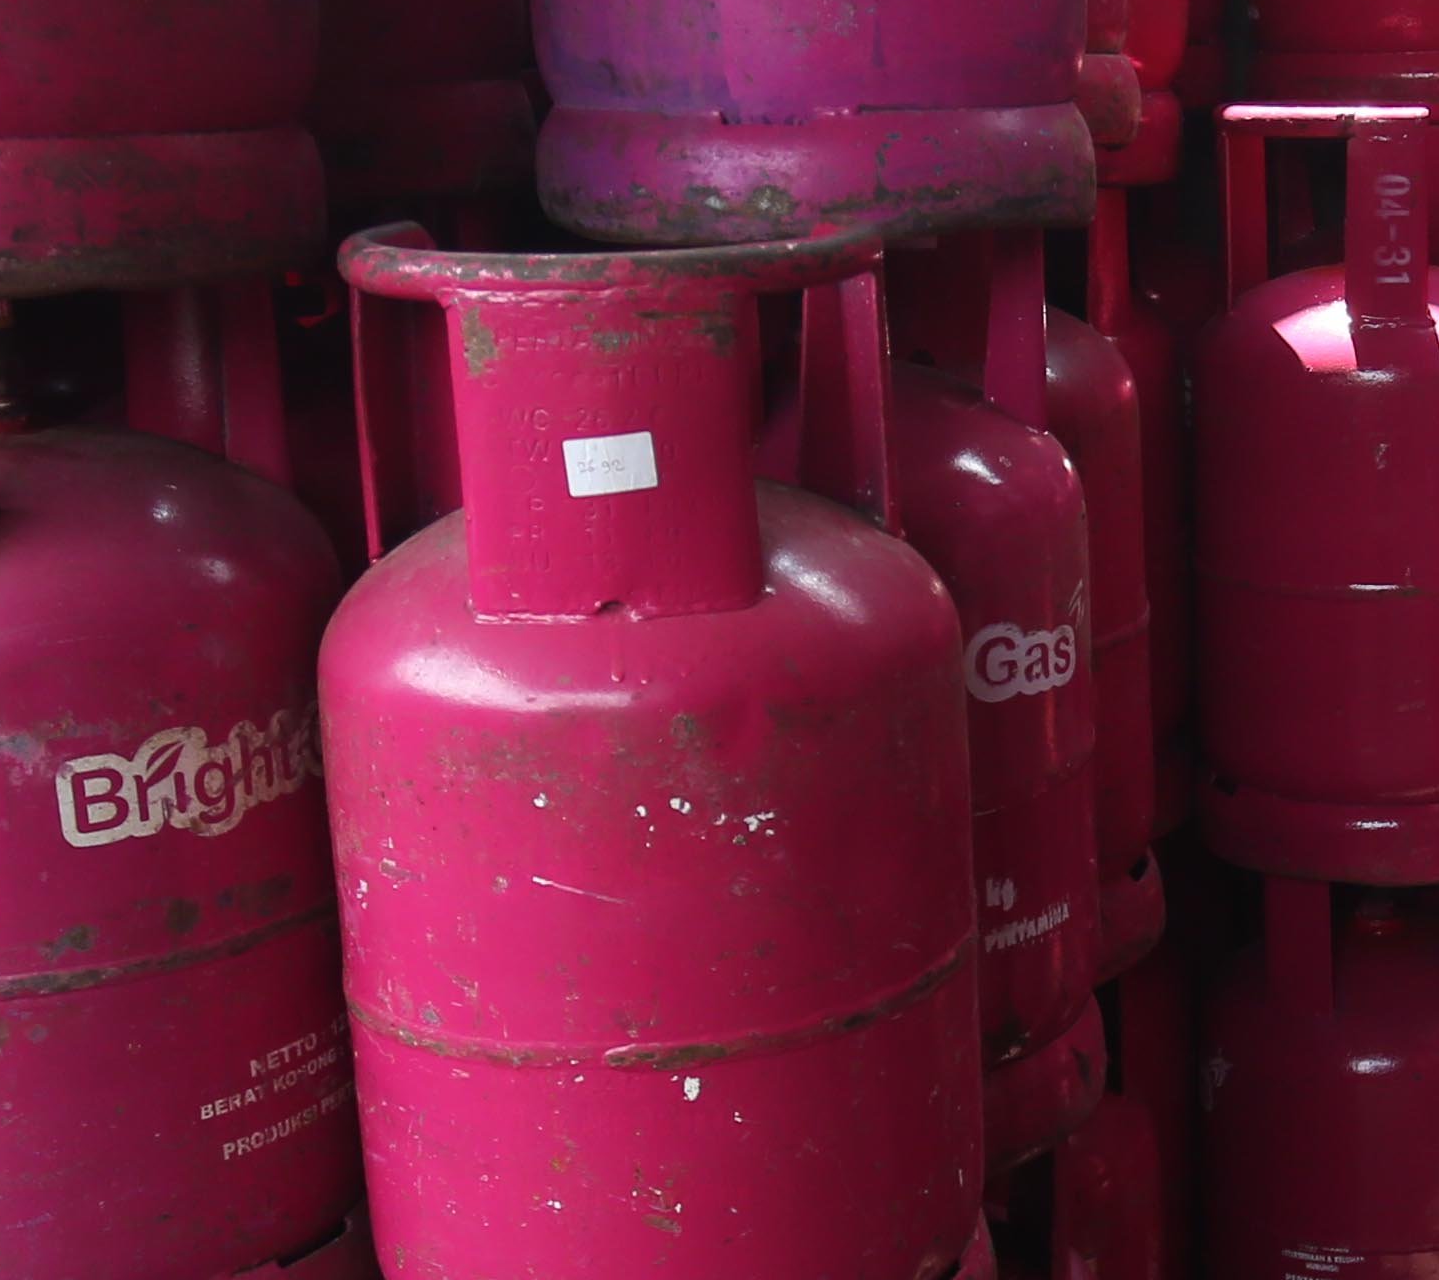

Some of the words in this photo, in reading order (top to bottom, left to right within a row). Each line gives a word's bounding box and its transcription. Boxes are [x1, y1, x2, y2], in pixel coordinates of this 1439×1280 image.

[1373, 173, 1411, 286] 04-31
[965, 623, 1075, 702] Gas
[57, 718, 306, 847] Bright
[200, 1083, 267, 1120] BERAT
